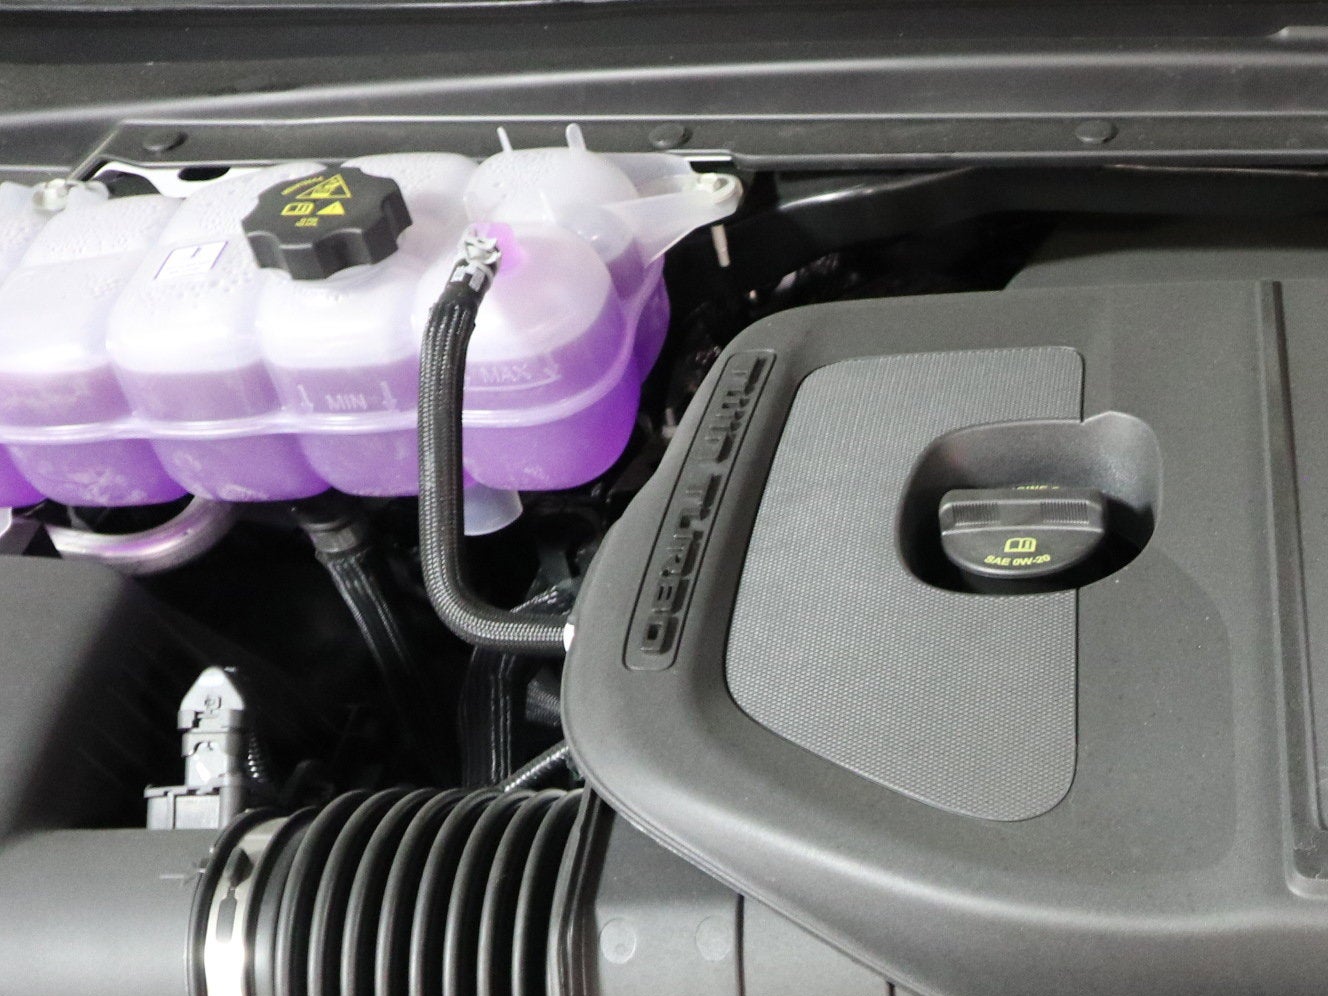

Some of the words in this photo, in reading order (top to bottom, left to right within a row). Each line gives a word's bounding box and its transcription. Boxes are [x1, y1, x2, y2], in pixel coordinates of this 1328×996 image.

[480, 364, 531, 384] MAX
[327, 393, 367, 410] MIN
[639, 474, 722, 654] TURBO
[984, 554, 1011, 566] SAE
[1012, 553, 1051, 566] 0W-20
